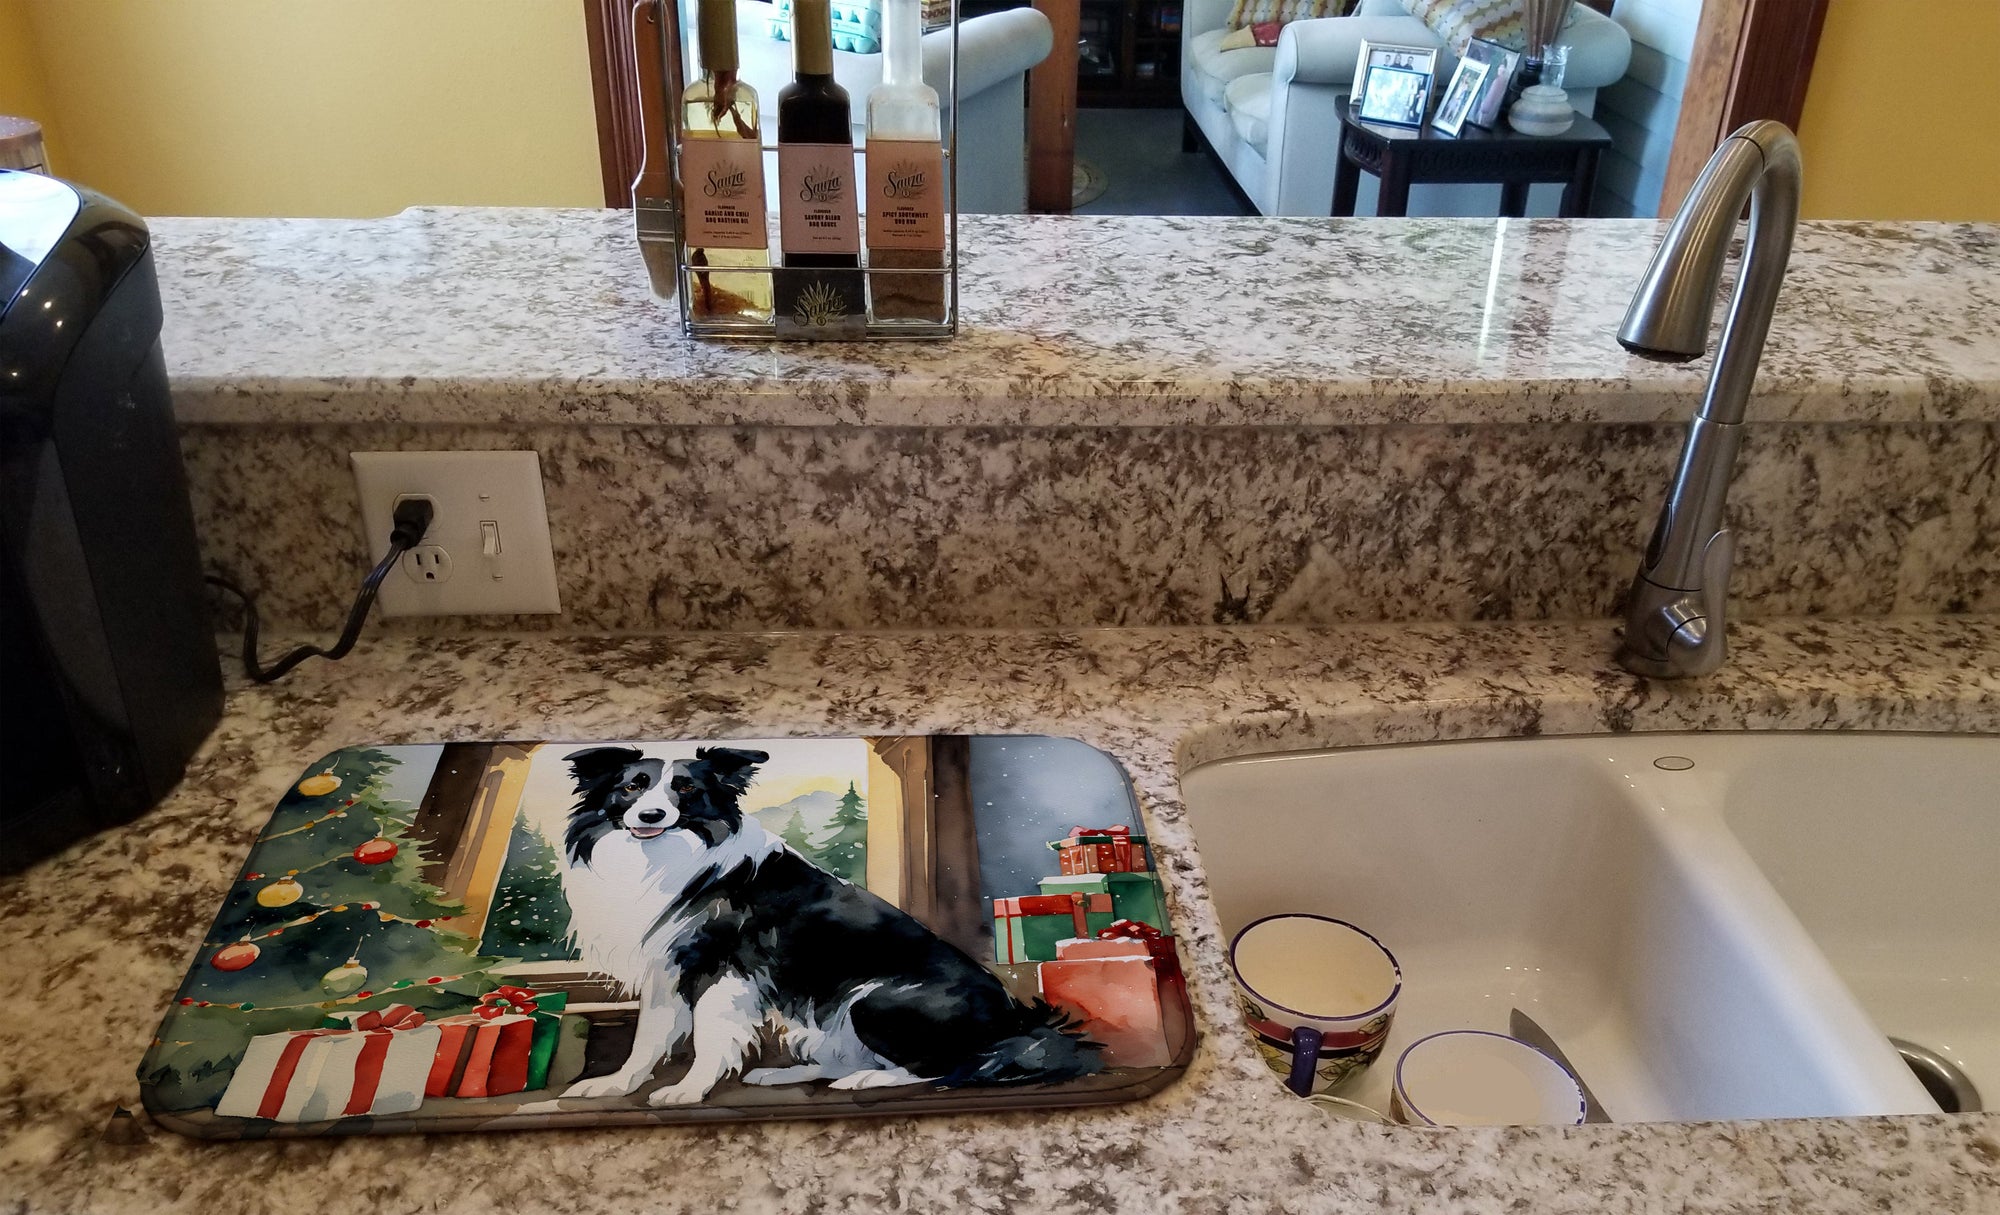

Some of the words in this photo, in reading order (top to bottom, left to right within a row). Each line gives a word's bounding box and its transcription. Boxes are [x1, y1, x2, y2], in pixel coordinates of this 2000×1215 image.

[704, 170, 746, 197] Sauza
[800, 176, 841, 201] Sauza
[884, 171, 925, 198] Sauza
